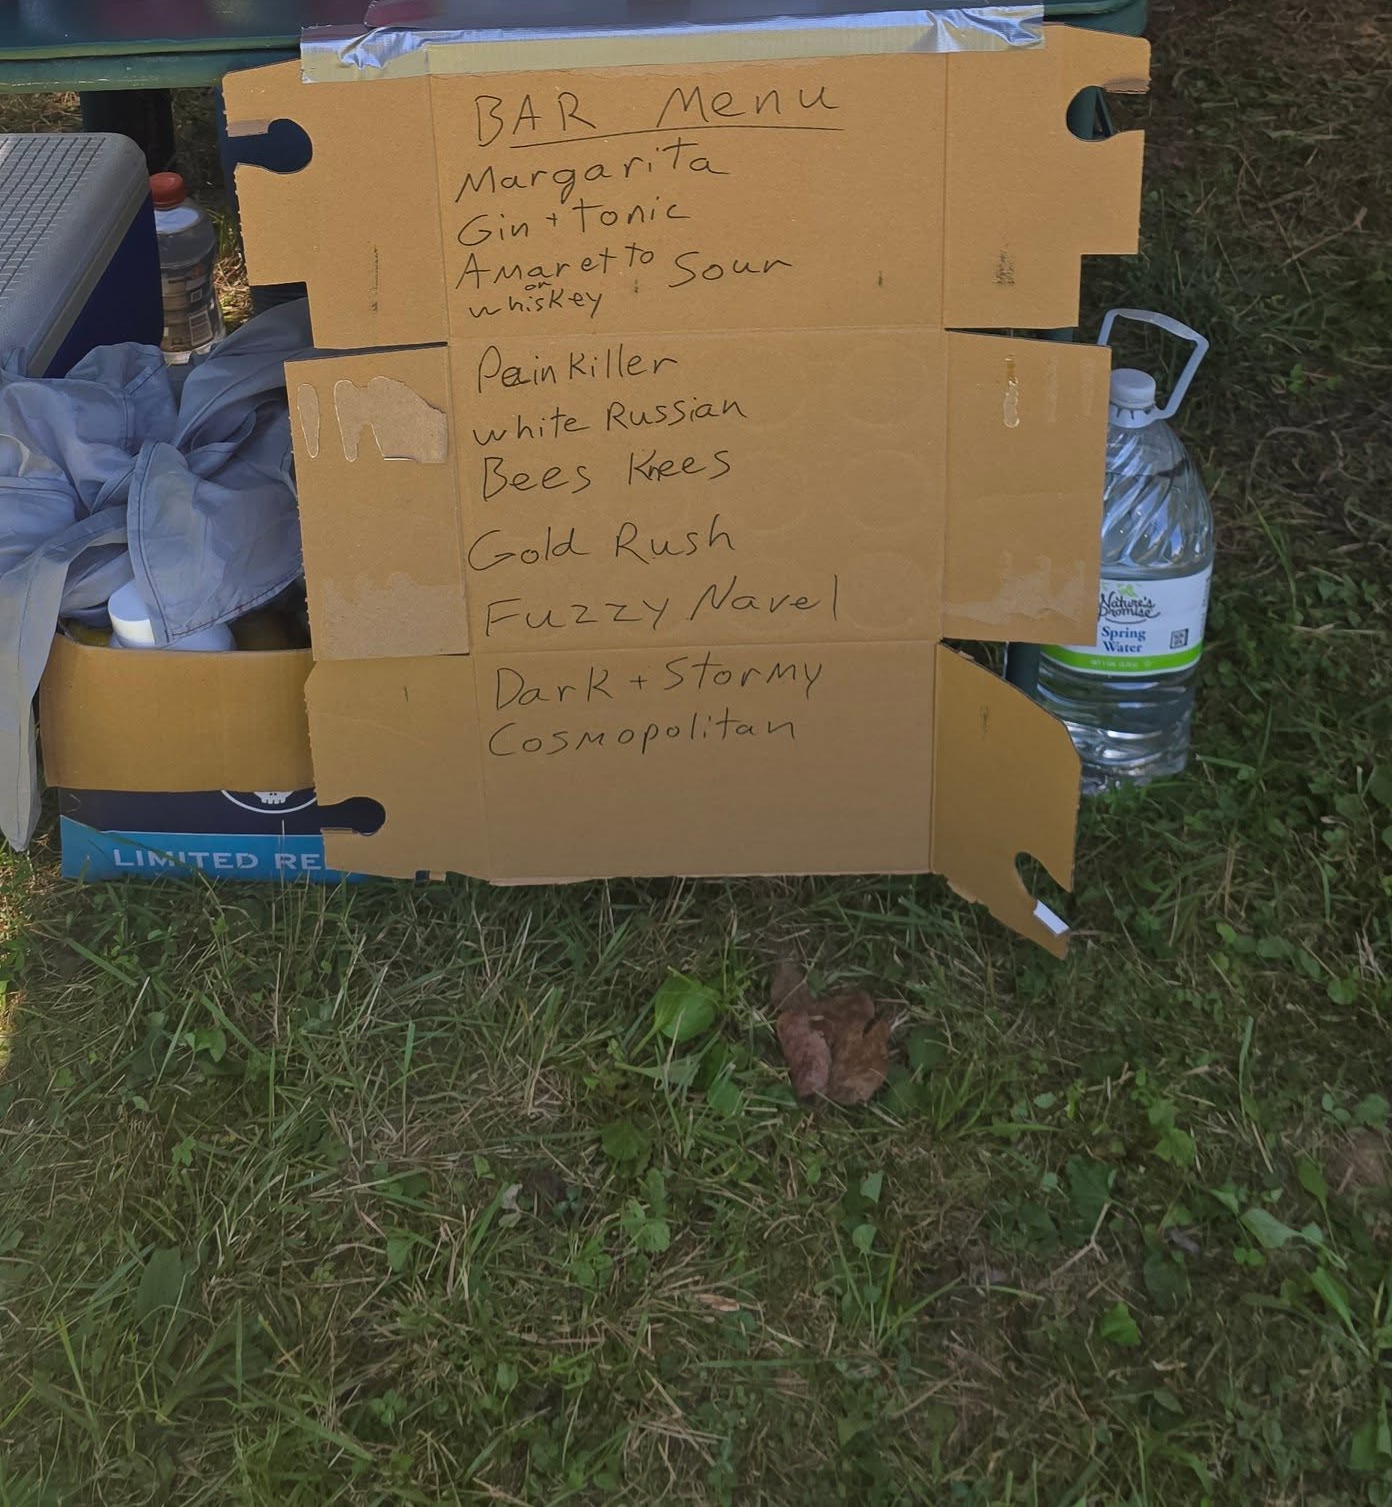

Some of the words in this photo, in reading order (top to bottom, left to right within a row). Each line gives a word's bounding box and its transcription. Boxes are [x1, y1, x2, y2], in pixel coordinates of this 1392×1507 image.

[475, 92, 596, 146] BAR
[656, 85, 839, 127] Menu
[455, 137, 731, 204] Margarita
[457, 214, 528, 246] Gin
[455, 242, 654, 290] Amaretto
[668, 250, 792, 287] Sour
[524, 281, 552, 291] or
[606, 396, 748, 430] Russian
[482, 455, 591, 501] Bees
[627, 449, 731, 485] Knees
[468, 525, 590, 571] Gold
[615, 513, 736, 565] Rush
[689, 574, 838, 622] Navel
[1102, 626, 1147, 642] Spring
[1103, 641, 1143, 653] Water
[630, 673, 648, 690] +
[488, 707, 796, 756] Cosmopolitan
[113, 849, 259, 869] LIMITED
[274, 853, 322, 871] RE
